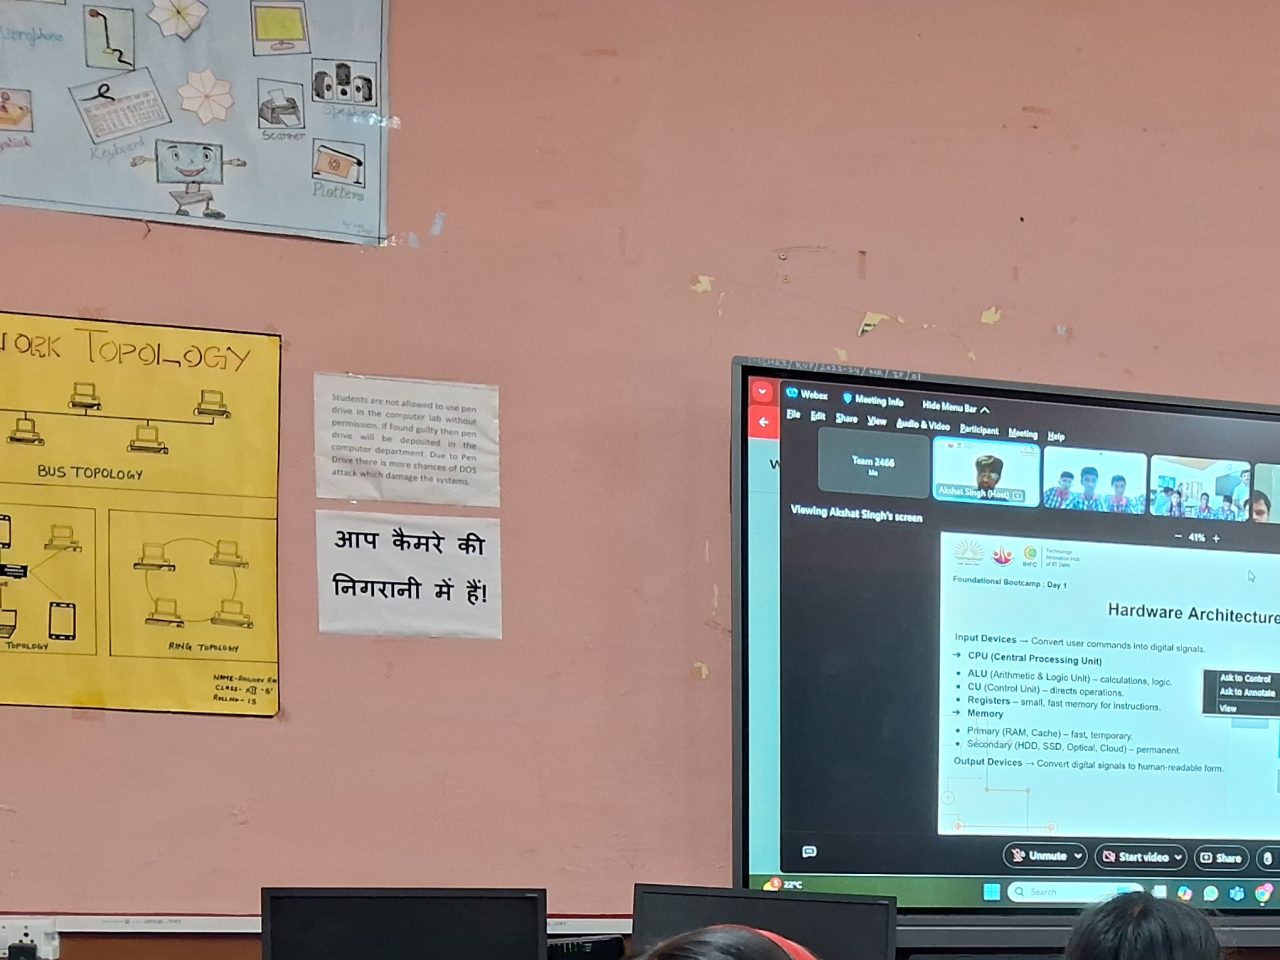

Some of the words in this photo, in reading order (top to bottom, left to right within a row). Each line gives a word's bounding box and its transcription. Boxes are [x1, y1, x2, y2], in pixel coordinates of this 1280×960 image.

[89, 137, 145, 162] Keyboard
[312, 182, 365, 202] Plotters
[74, 327, 251, 373] TOPOLOGY
[332, 394, 368, 404] Students
[401, 399, 432, 410] allowed
[801, 389, 828, 401] Webex
[855, 394, 887, 407] Meeting
[888, 397, 904, 407] Info
[922, 401, 941, 411] Hide
[942, 402, 963, 413] Menu
[964, 404, 977, 414] Bar
[332, 406, 352, 414] drive
[386, 412, 425, 421] computer
[446, 415, 477, 426] without
[332, 418, 377, 430] permission.
[390, 422, 414, 432] found
[416, 424, 438, 436] guilty
[440, 426, 459, 436] then
[462, 430, 477, 438] pen
[786, 409, 801, 419] File
[811, 411, 826, 422] Edit
[835, 413, 858, 424] Share
[867, 415, 887, 426] View
[896, 418, 919, 429] Audio
[928, 421, 951, 431] Video
[960, 424, 999, 436] Participant
[1008, 428, 1038, 440] Meeting
[1048, 431, 1065, 442] Help
[332, 431, 352, 440] drive
[360, 432, 374, 441] will
[382, 434, 392, 442] be
[400, 436, 440, 448] deposited
[448, 440, 456, 448] in
[463, 442, 477, 450] the
[332, 444, 371, 454] computer
[430, 450, 446, 459] Due
[450, 452, 458, 460] to
[462, 454, 476, 462] Pen
[852, 455, 873, 467] Team
[37, 464, 67, 478] BUS
[70, 465, 143, 481] TOPOLOGY
[332, 456, 354, 464] Drive
[356, 456, 378, 466] there
[380, 459, 386, 467] is
[414, 462, 446, 472] chances
[448, 464, 456, 472] of
[460, 466, 477, 474] DOS
[869, 469, 878, 477] Me
[332, 468, 356, 477] attack
[360, 470, 383, 479] which
[386, 472, 418, 482] damage
[420, 474, 434, 482] the
[436, 476, 470, 486] systems.
[938, 486, 963, 496] Akshat
[964, 487, 986, 498] Singh
[988, 488, 1010, 500] (Host)
[791, 504, 828, 518] Viewing
[829, 507, 859, 519] Akshat
[861, 509, 893, 522] Singh's
[895, 513, 923, 523] screen
[334, 531, 379, 549] आप
[392, 528, 445, 554] कैमरे
[457, 533, 486, 555] की
[332, 573, 422, 599] निगरानी
[434, 578, 454, 601] में
[466, 579, 487, 605] हैं!
[953, 575, 1001, 585] Foundational
[1004, 579, 1041, 588] Bootcamp
[1047, 581, 1061, 589] Day
[1109, 602, 1183, 619] Hardware
[5, 641, 49, 652] TOPOLOGY
[168, 641, 192, 652] RING
[197, 643, 239, 653] TOPOLOGY
[955, 633, 979, 645] Input
[981, 634, 1017, 644] Devices
[1031, 637, 1064, 647] Convert
[1066, 640, 1084, 648] user
[1086, 639, 1131, 650] commands
[1133, 641, 1149, 651] into
[1150, 642, 1175, 654] digital
[1176, 644, 1206, 656] signals.
[968, 651, 988, 660] CPU
[990, 652, 1027, 663] (Central
[1029, 654, 1079, 666] Processing
[1081, 656, 1103, 666] Unit)
[968, 669, 988, 678] ALU
[990, 670, 1036, 681] (Arithmetic
[1037, 672, 1044, 680] &
[1046, 673, 1069, 683] Logic
[1071, 674, 1091, 684] Unit)
[1100, 676, 1150, 687] calculations,
[1151, 678, 1173, 688] logic.
[1220, 673, 1233, 682] Ask
[1234, 674, 1243, 682] to
[1244, 674, 1271, 684] Control
[968, 683, 982, 691] CU
[984, 683, 1018, 693] (Control
[1020, 684, 1040, 695] Unit)
[1050, 687, 1077, 696] directs
[1080, 688, 1124, 698] operations.
[1220, 687, 1233, 697] Ask
[1234, 688, 1242, 697] to
[1244, 689, 1276, 698] Annotate
[968, 696, 1011, 707] Registers
[1021, 698, 1044, 708] small,
[1048, 698, 1063, 708] fast
[1065, 701, 1099, 712] memory
[1100, 701, 1111, 710] for
[1113, 701, 1161, 712] instructions.
[1220, 704, 1237, 714] View
[967, 709, 1003, 720] Memory
[967, 727, 1000, 738] Primary
[1002, 728, 1029, 738] (RAM,
[1031, 729, 1061, 739] Cache)
[1071, 730, 1088, 740] fast,
[1090, 731, 1133, 741] temporary.
[967, 739, 1012, 751] Secondary
[1014, 741, 1040, 752] (HDD,
[1043, 742, 1065, 752] SSD,
[1067, 742, 1098, 754] Optical,
[1100, 744, 1127, 755] Cloud)
[1136, 746, 1181, 756] permanent.
[954, 757, 985, 768] Output
[987, 757, 1023, 767] Devices
[1037, 759, 1070, 769] Convert
[1071, 760, 1096, 771] digital
[1097, 760, 1126, 771] signals
[1128, 762, 1136, 770] to
[1137, 762, 1203, 773] human-readable
[1204, 764, 1224, 773] form.
[1029, 851, 1067, 862] Unmute
[1119, 851, 1141, 862] Start
[1143, 852, 1169, 863] video
[1216, 853, 1242, 864] Share
[1030, 887, 1057, 896] Search
